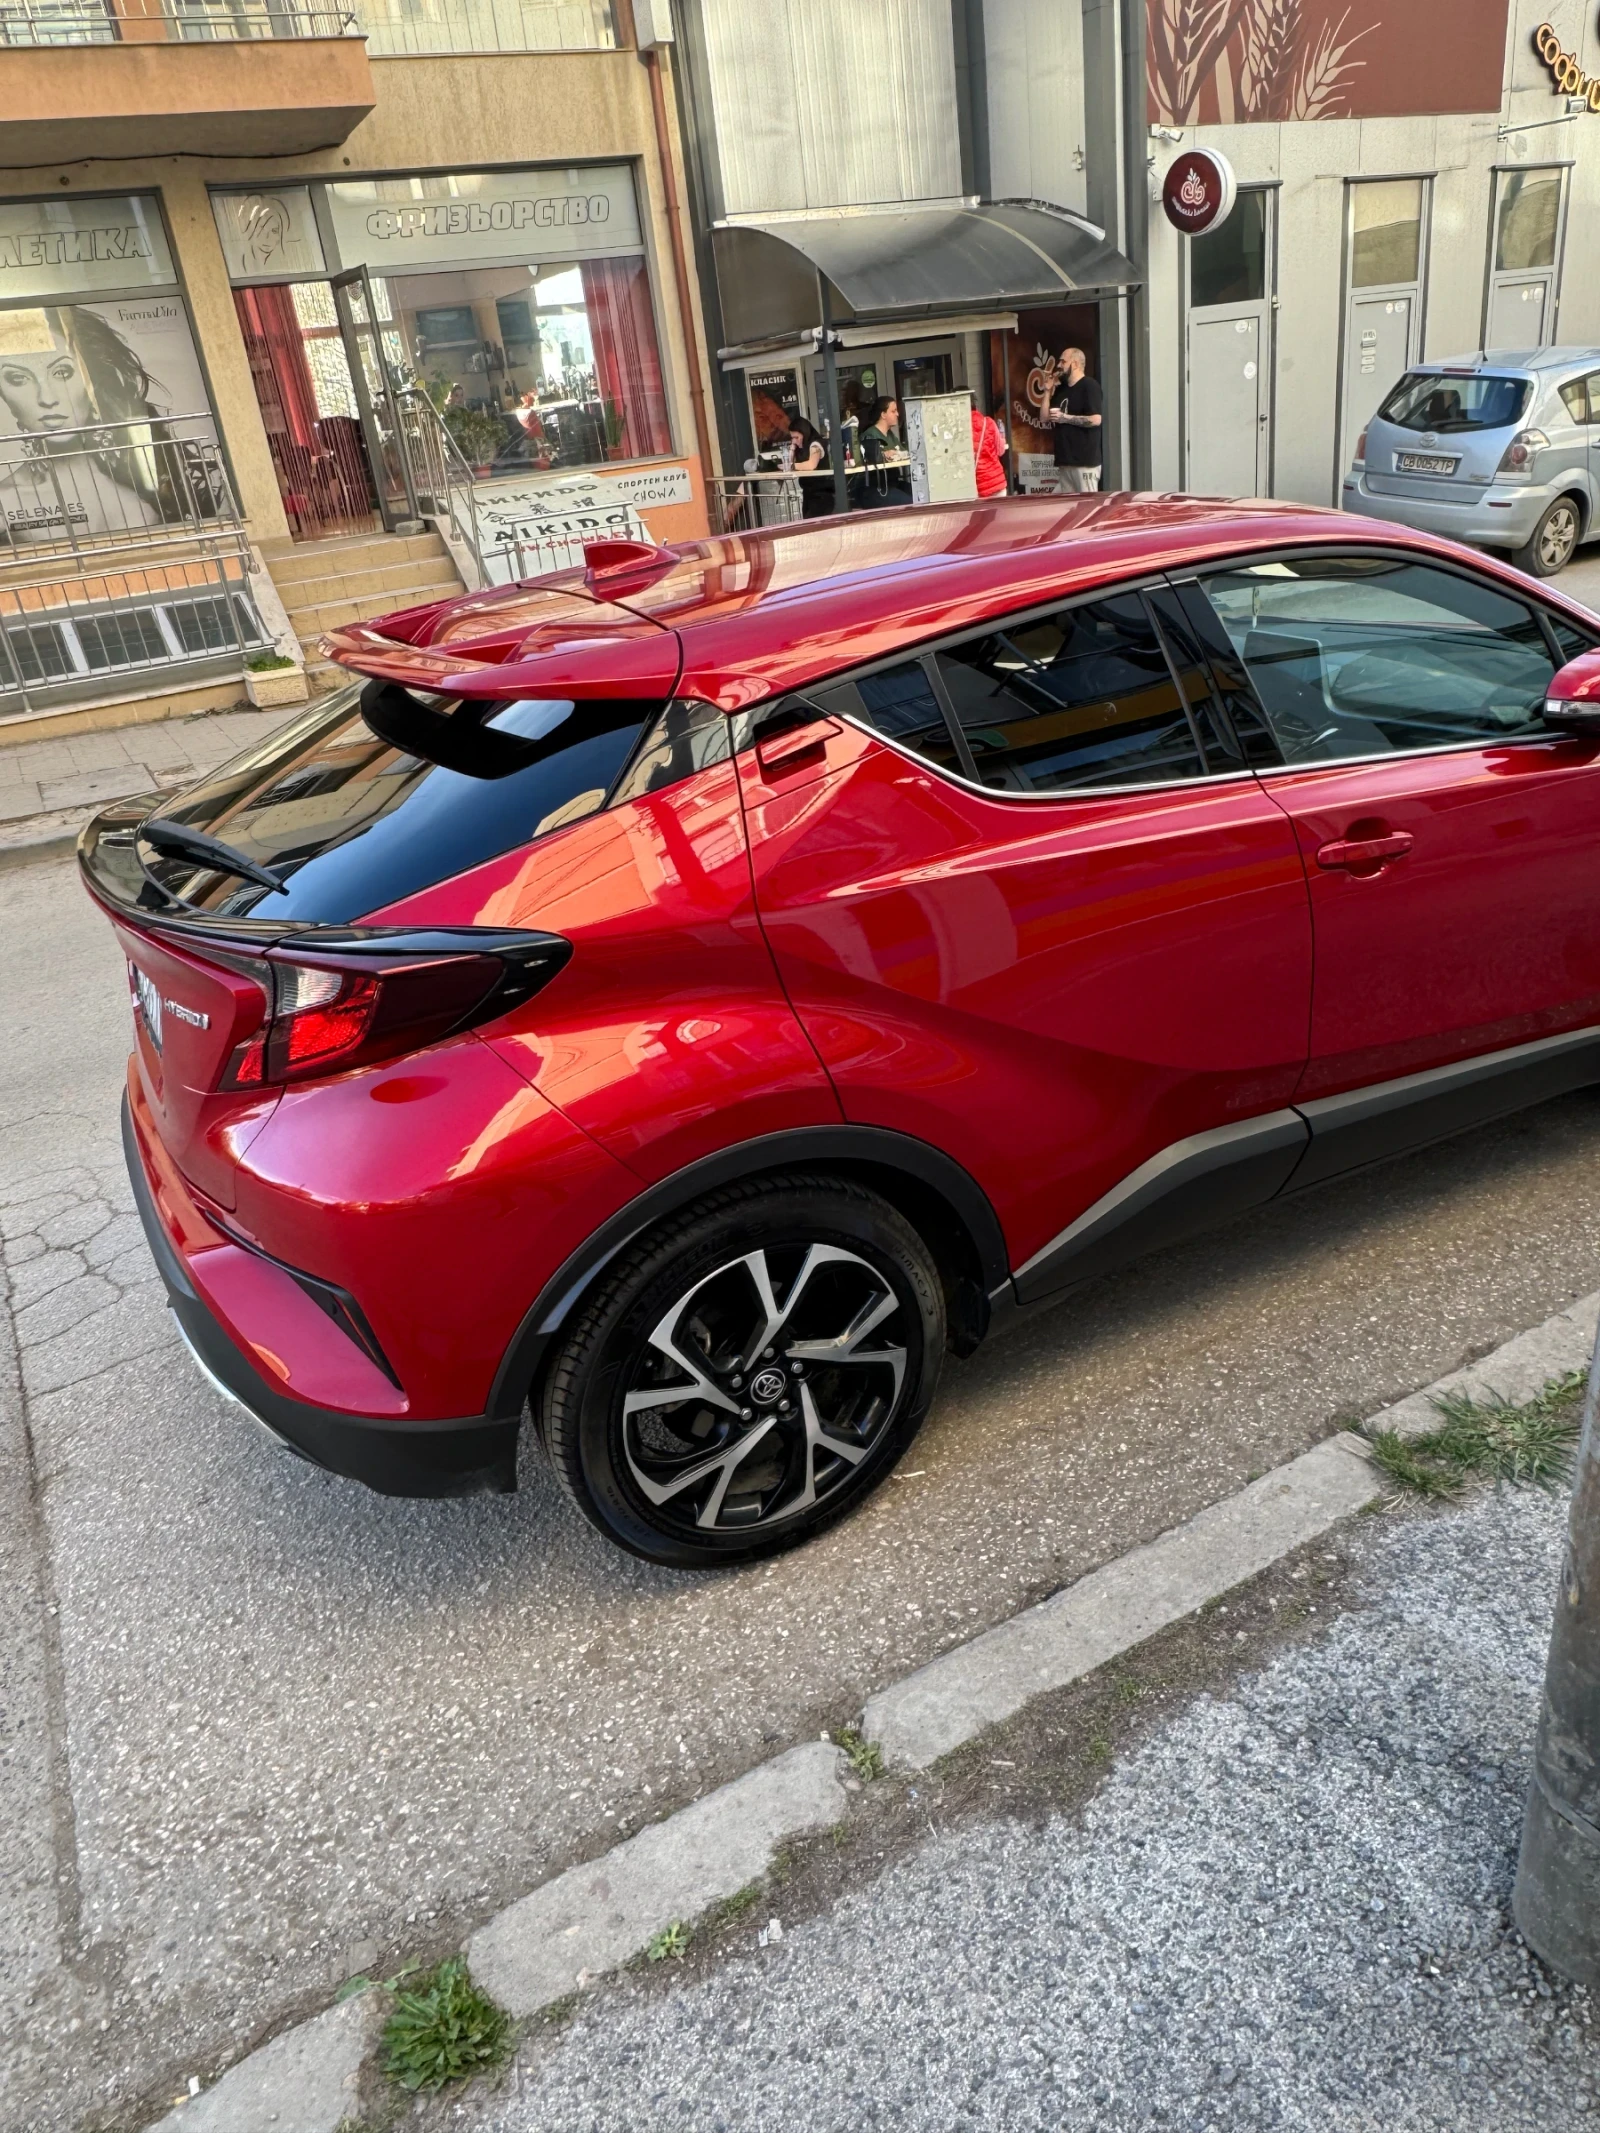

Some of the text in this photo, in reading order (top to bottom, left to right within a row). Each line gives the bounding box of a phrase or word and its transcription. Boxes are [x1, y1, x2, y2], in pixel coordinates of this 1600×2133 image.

[366, 194, 610, 240] ФРИЗЬОРСТВО
[617, 473, 687, 489] СПОРТЕН КЛУБ
[494, 513, 626, 542] AIKIDO
